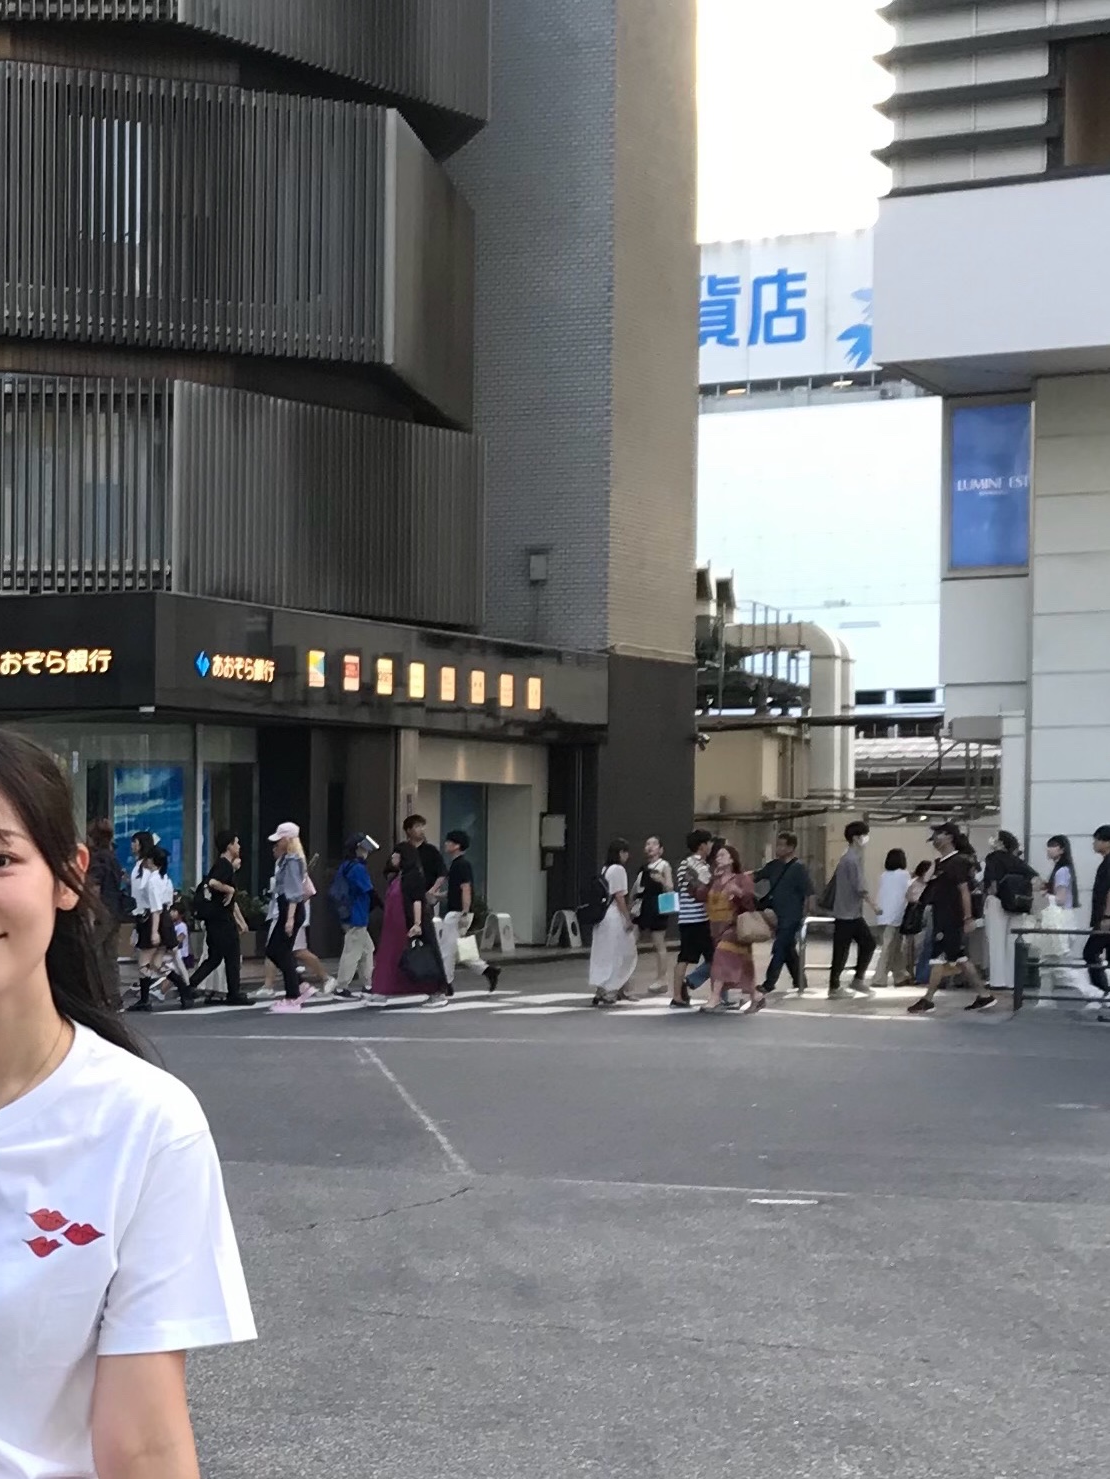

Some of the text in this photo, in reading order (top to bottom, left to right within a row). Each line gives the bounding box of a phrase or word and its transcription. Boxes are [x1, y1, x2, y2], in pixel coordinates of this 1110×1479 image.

[212, 654, 275, 683] あおぞら銀行
